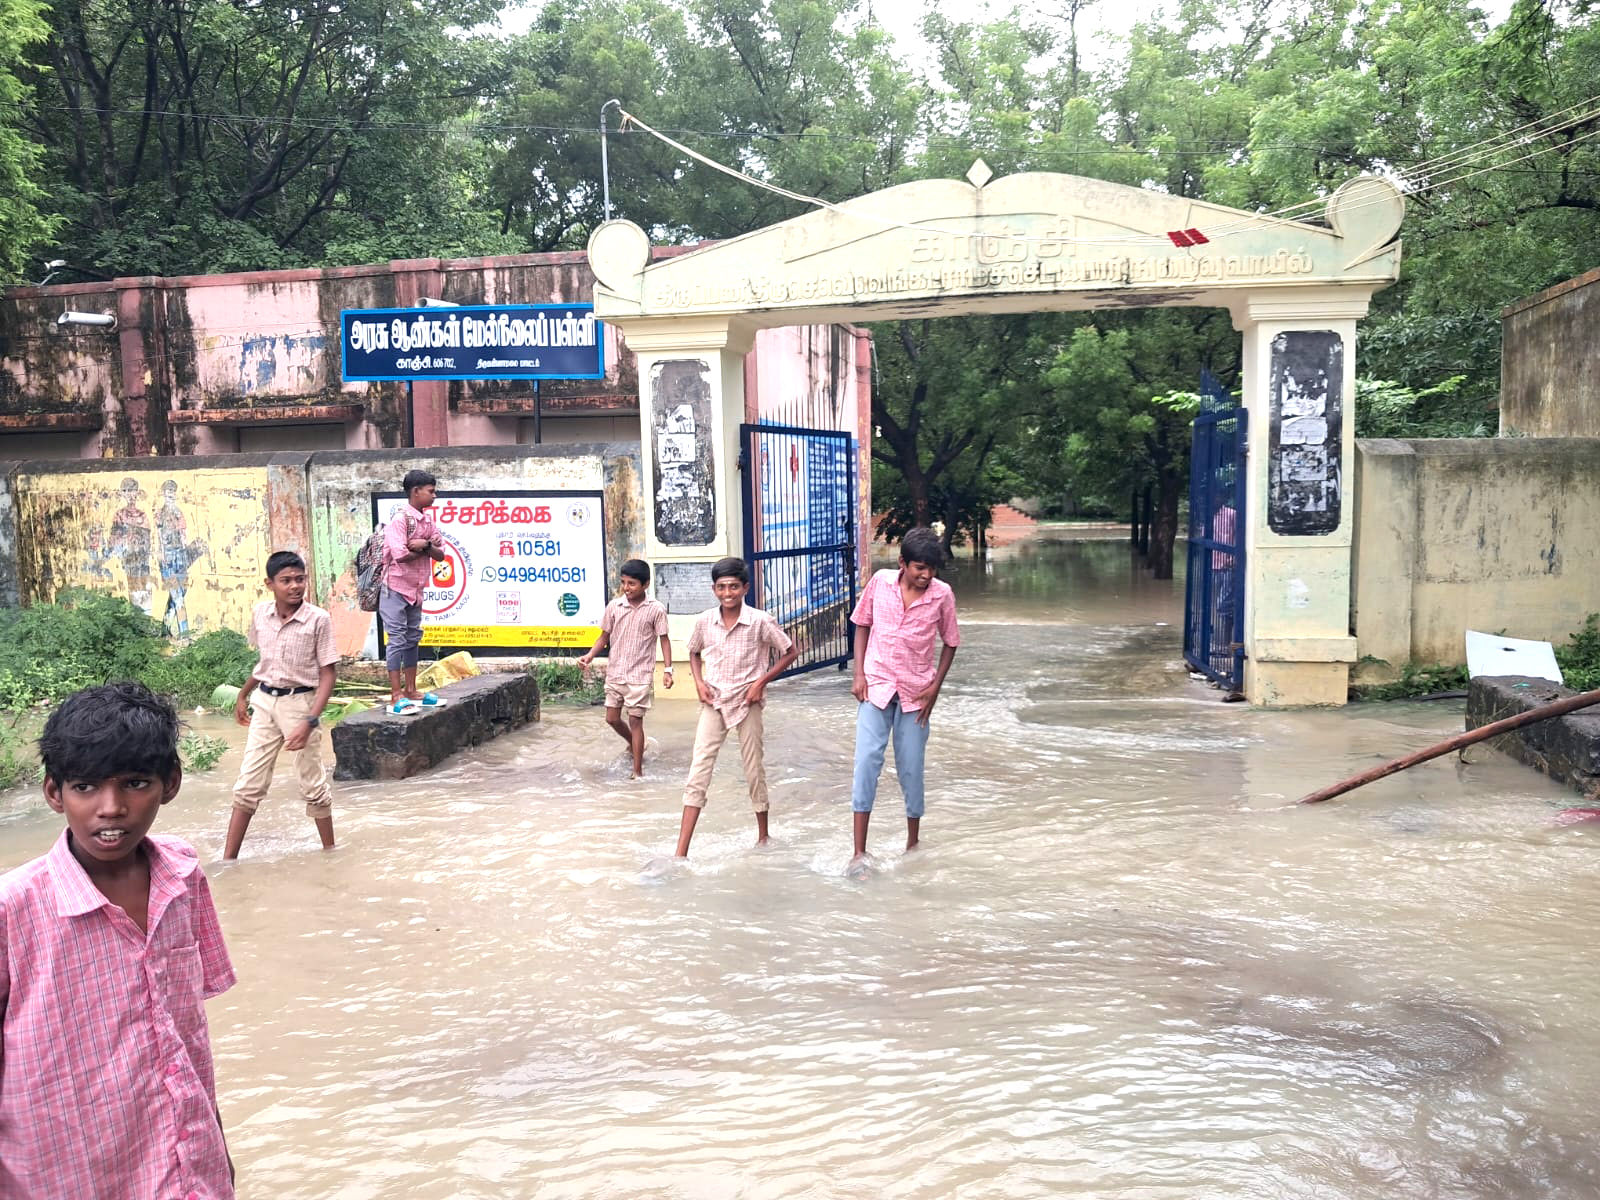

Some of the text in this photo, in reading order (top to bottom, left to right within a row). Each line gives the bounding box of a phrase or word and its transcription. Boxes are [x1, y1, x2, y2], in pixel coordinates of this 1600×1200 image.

[911, 215, 1078, 265] காஞ்சி
[350, 311, 596, 354] அரசு ஆண்கள் மேல்நிலைப் பள்ளி
[516, 540, 560, 556] 10581
[498, 567, 586, 583] 9498410581
[434, 611, 456, 622] TAMIL
